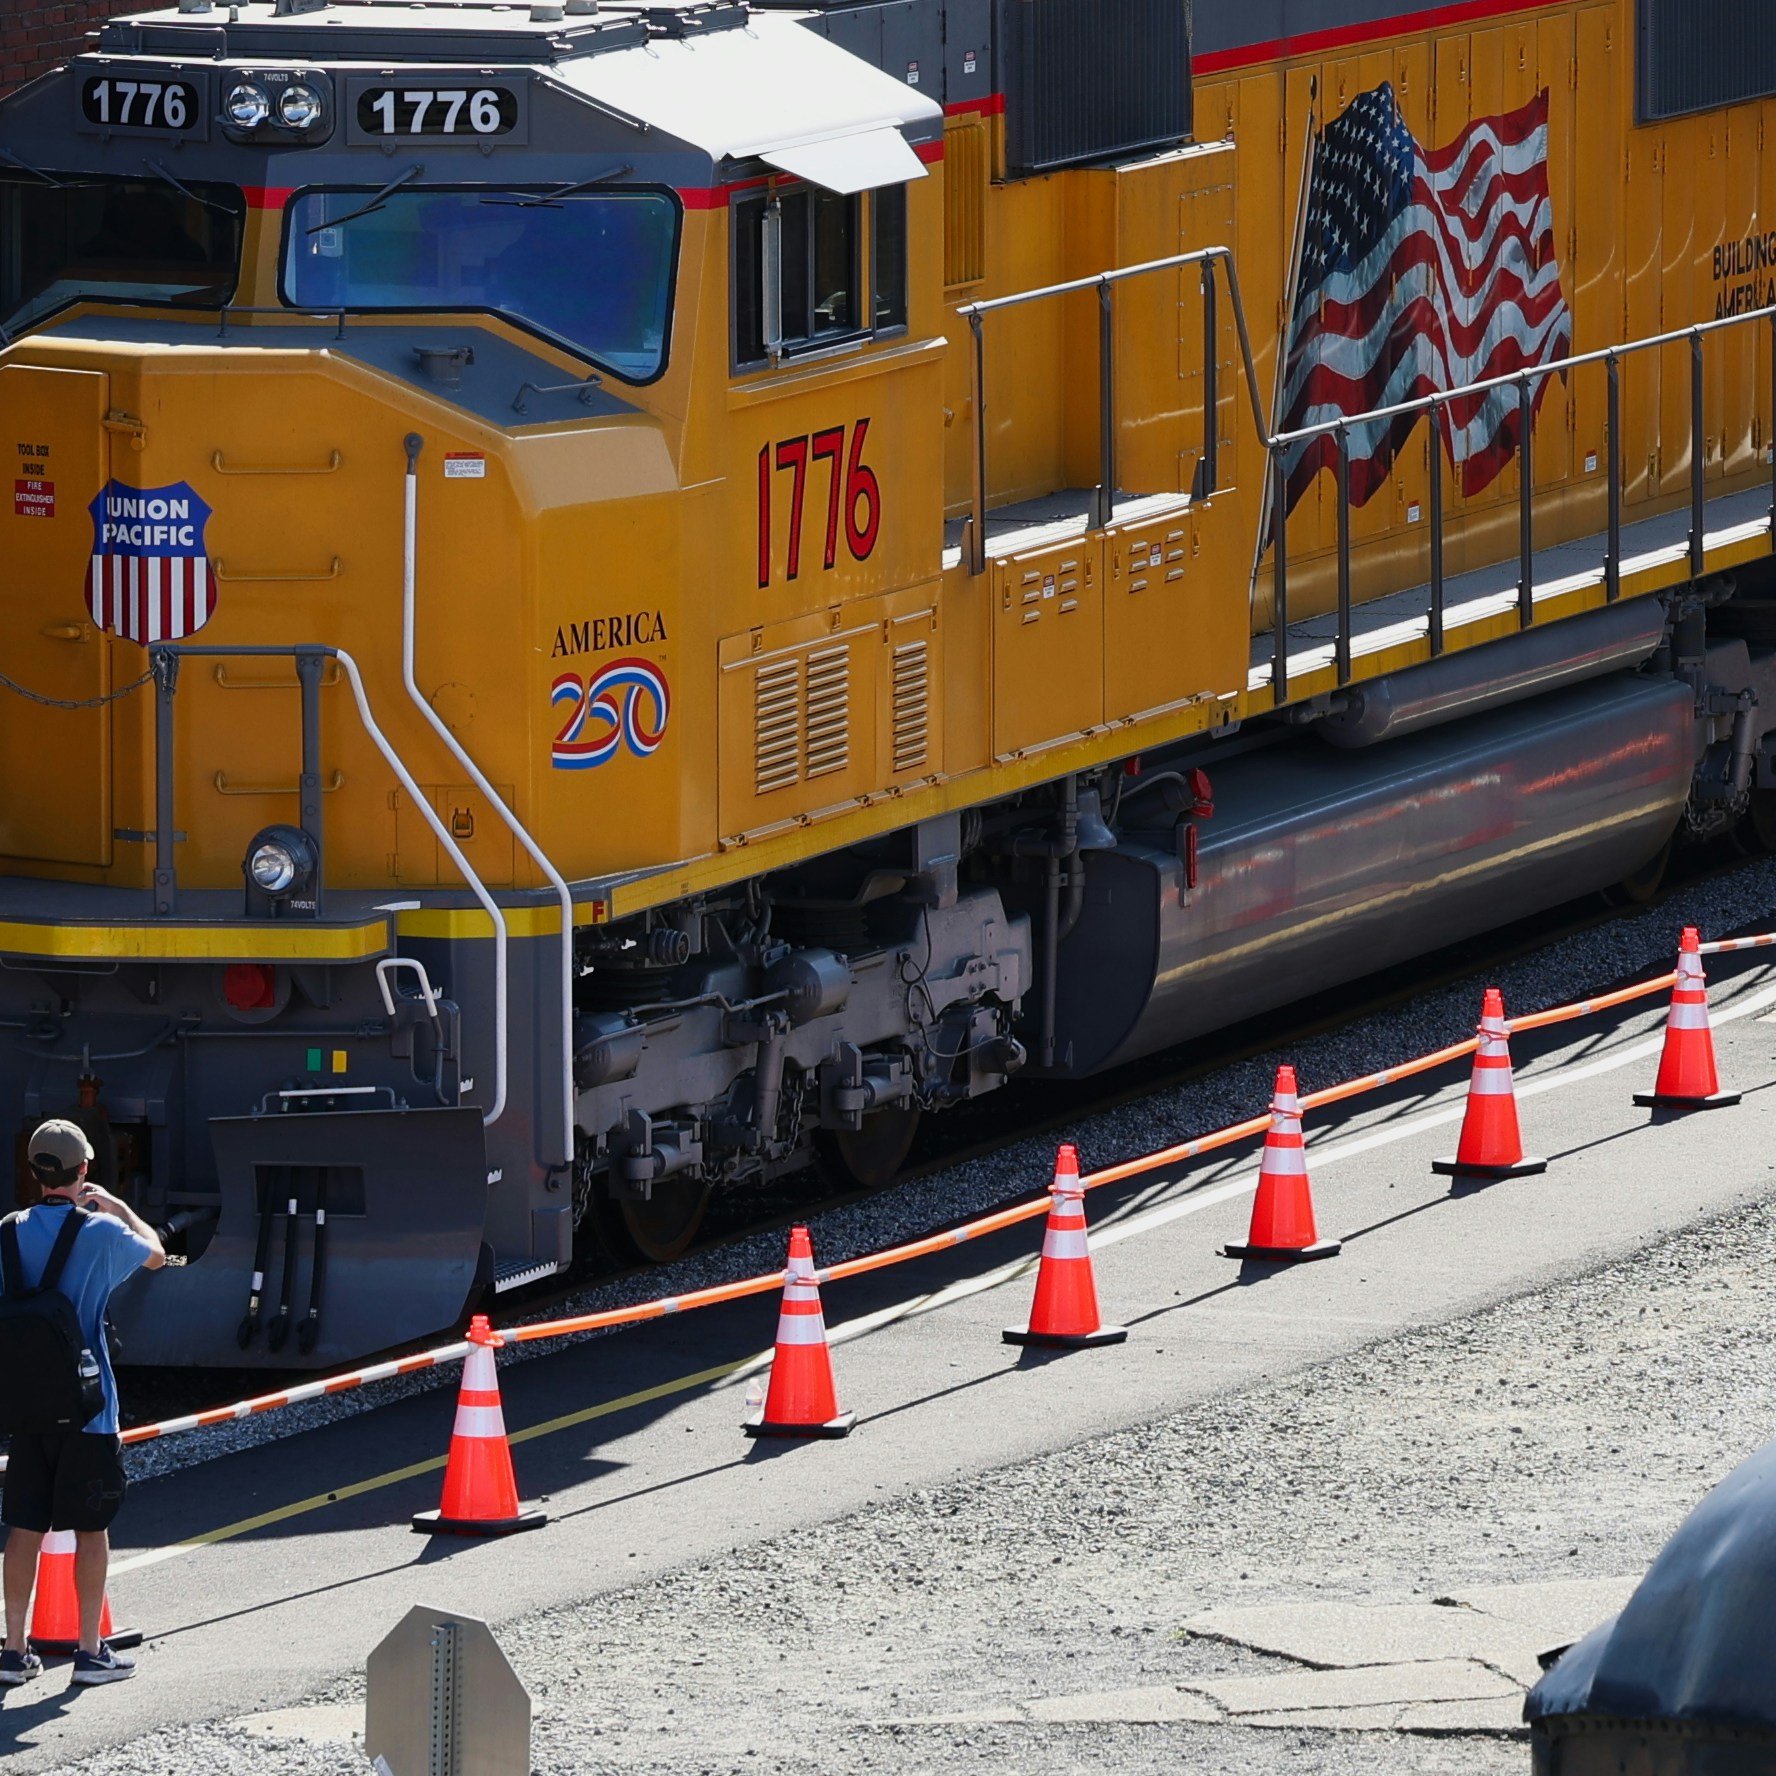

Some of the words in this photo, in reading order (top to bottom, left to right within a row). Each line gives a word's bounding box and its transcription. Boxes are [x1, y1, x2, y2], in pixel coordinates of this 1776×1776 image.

[91, 77, 188, 128] 1776
[370, 88, 503, 136] 1776
[17, 443, 34, 457] TOOL
[35, 444, 50, 458] BOX
[22, 463, 45, 476] INSIDE
[26, 481, 42, 491] FIRE
[15, 493, 54, 504] EXTINGUISHER
[106, 497, 189, 520] UNION
[757, 417, 881, 590] 1776
[23, 506, 46, 516] INSIDE
[102, 524, 194, 548] PACIFIC
[551, 609, 668, 658] AMERICA
[551, 657, 671, 771] 250
[592, 900, 605, 923] F
